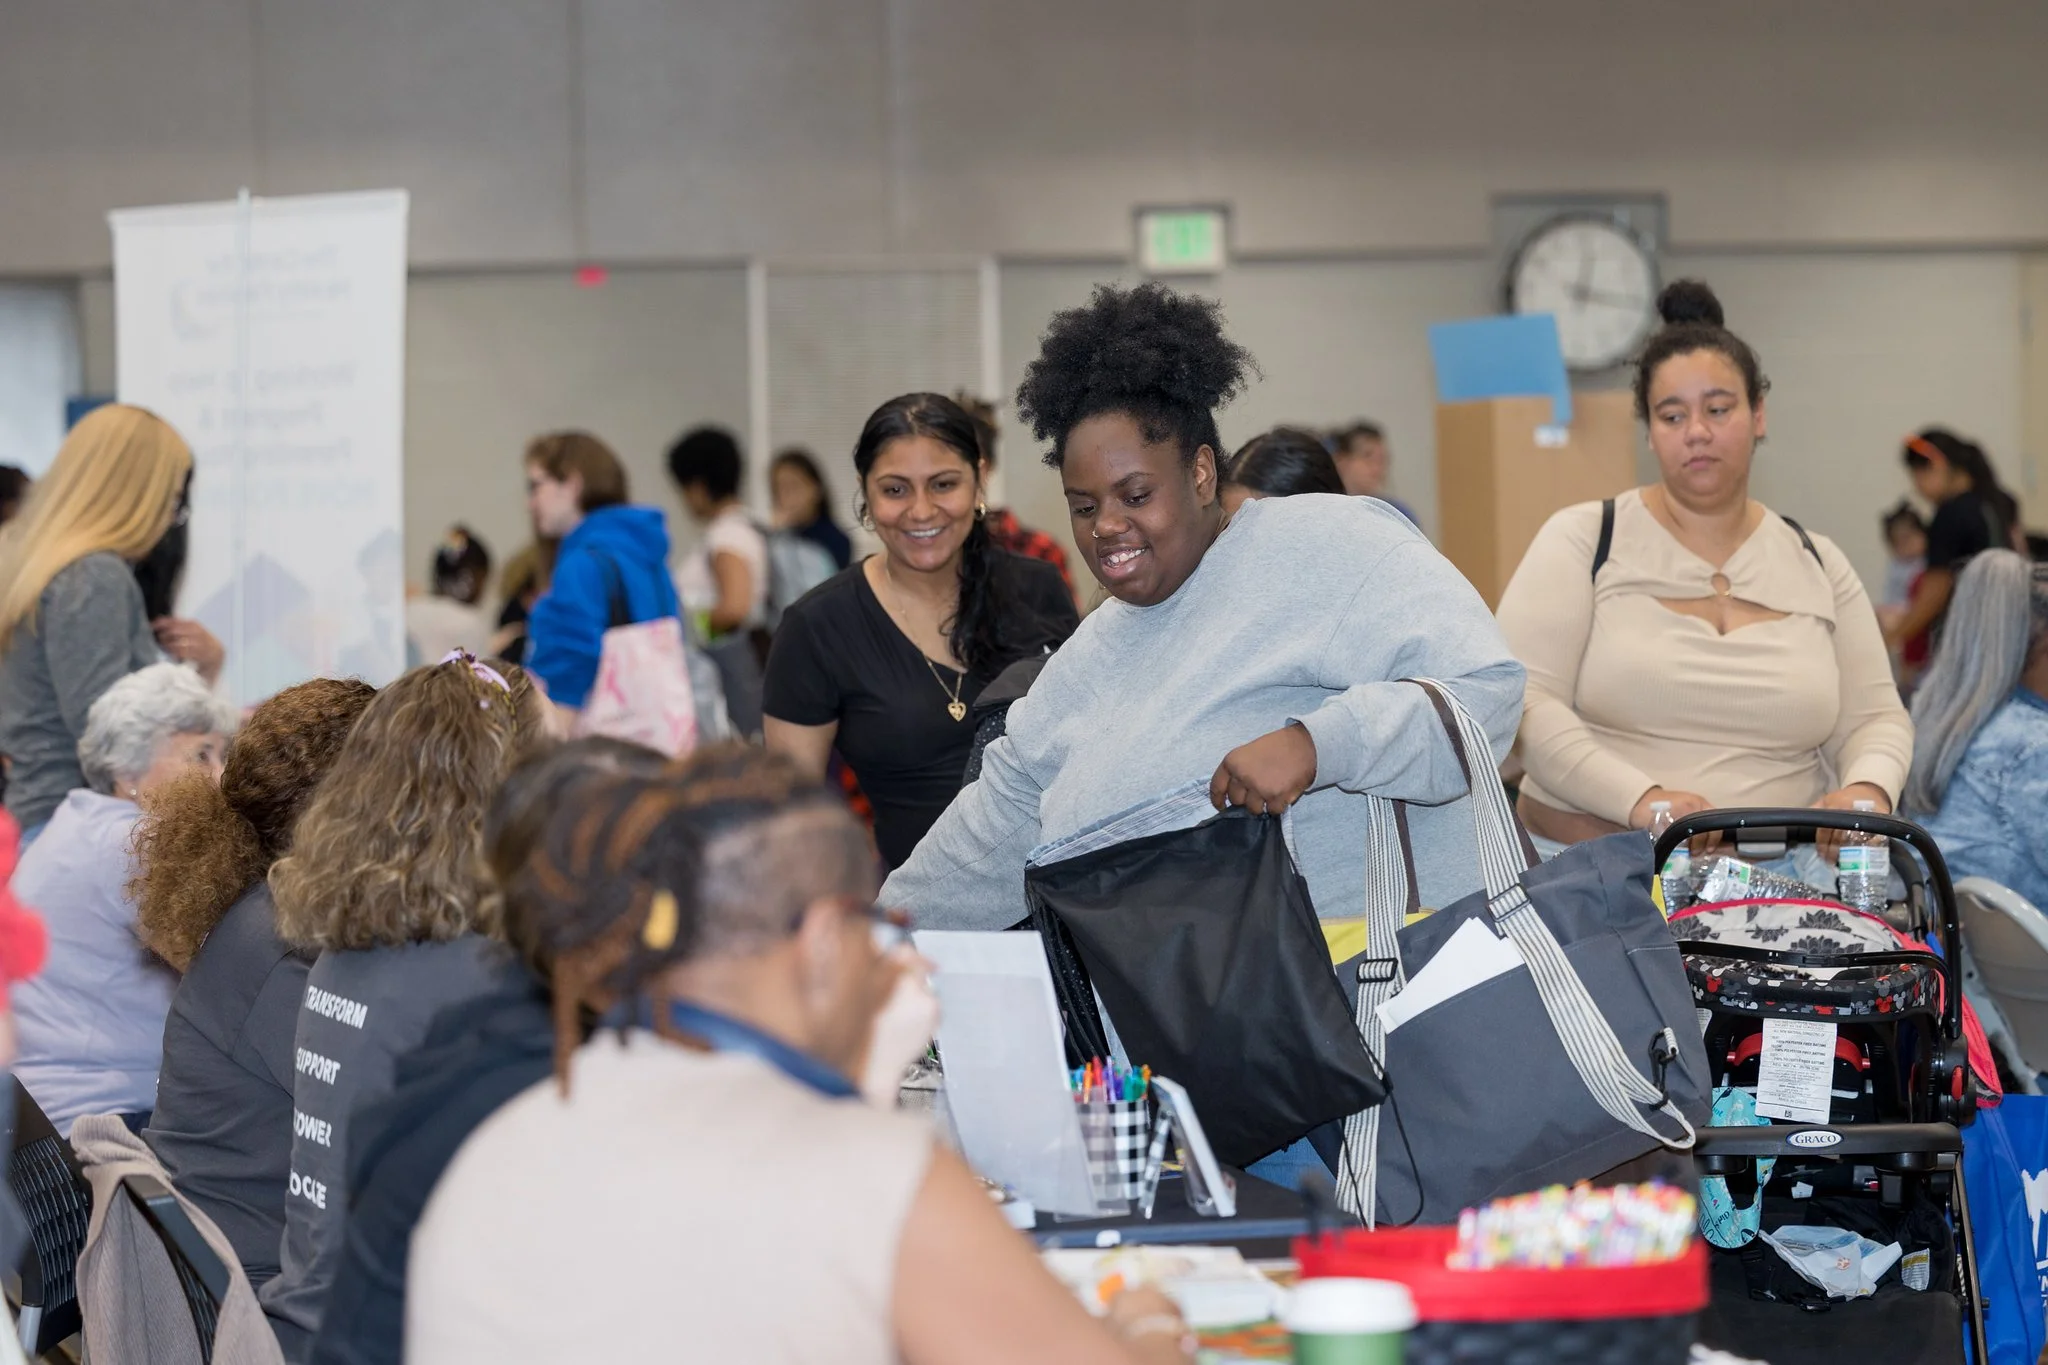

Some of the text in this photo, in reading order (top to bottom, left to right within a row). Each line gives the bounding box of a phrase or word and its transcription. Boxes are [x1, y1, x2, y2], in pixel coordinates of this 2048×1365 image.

[305, 985, 368, 1029] TRANSFORM
[297, 1047, 341, 1085] SUPPORT
[1794, 1134, 1837, 1144] GRACO
